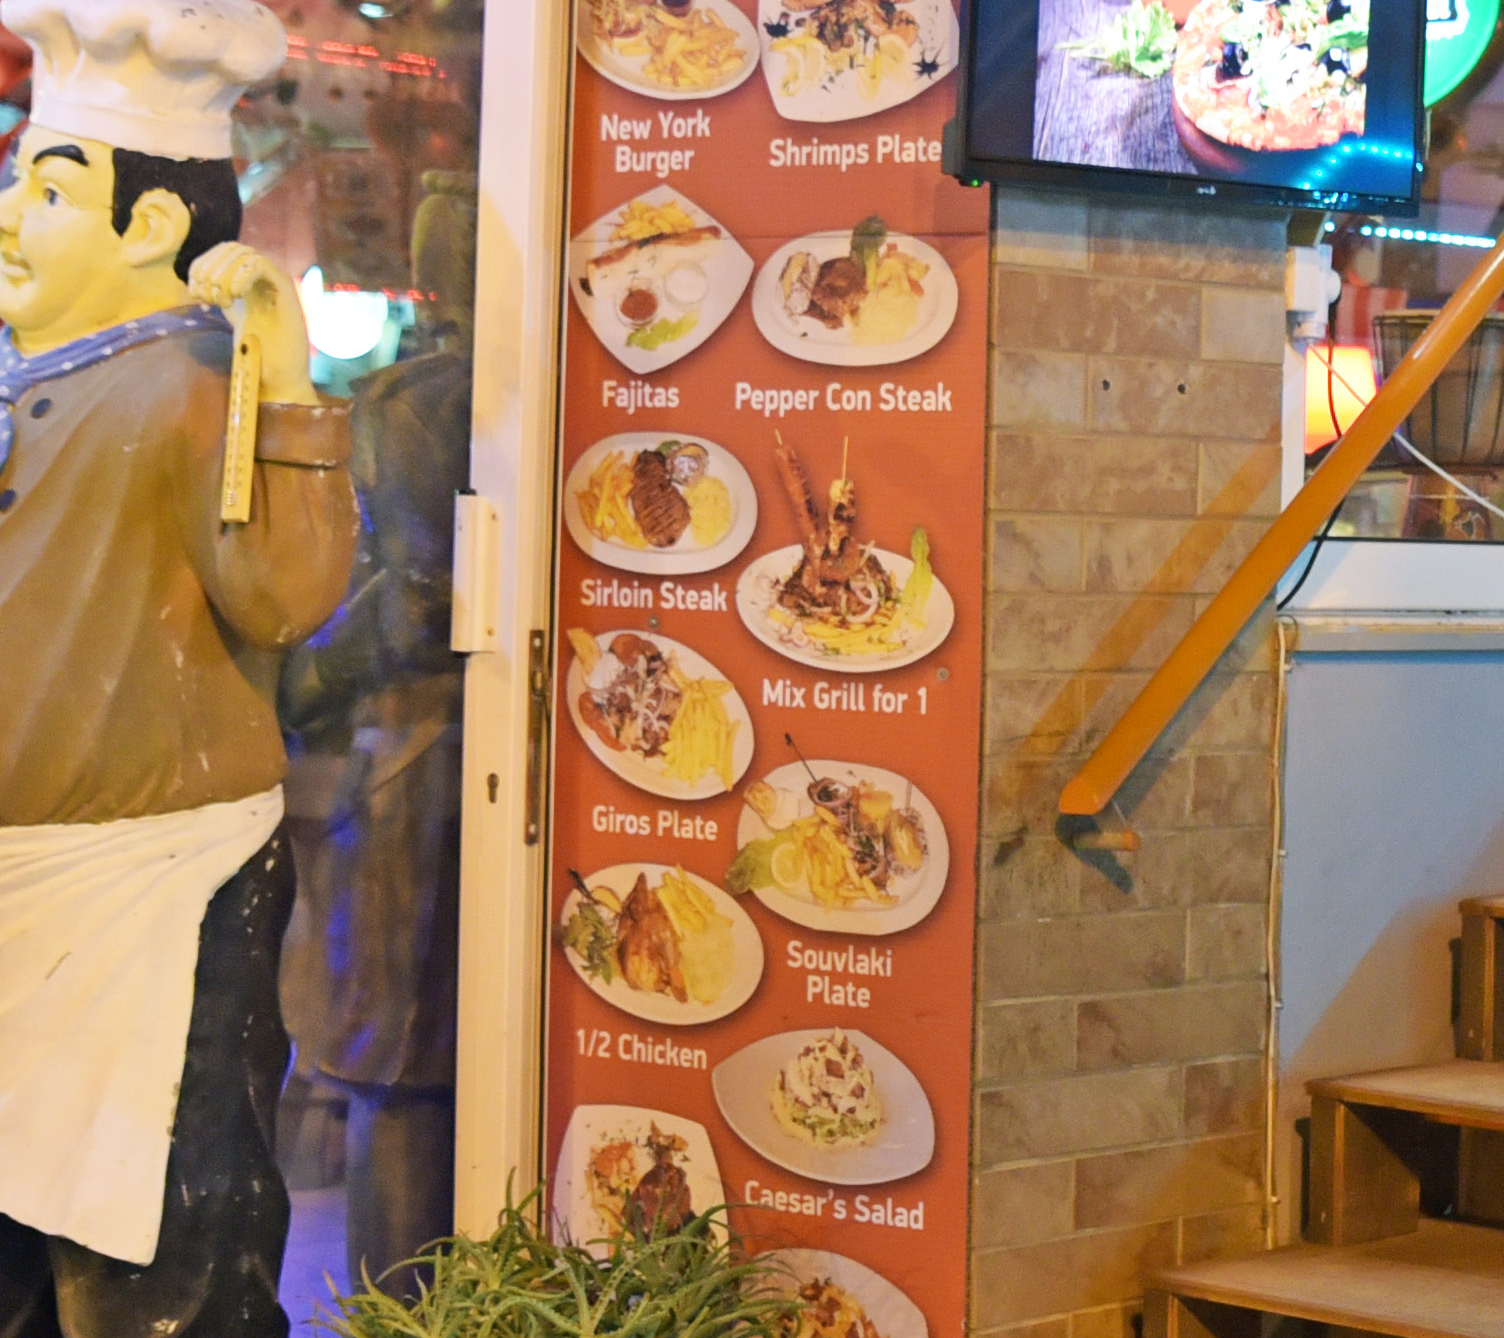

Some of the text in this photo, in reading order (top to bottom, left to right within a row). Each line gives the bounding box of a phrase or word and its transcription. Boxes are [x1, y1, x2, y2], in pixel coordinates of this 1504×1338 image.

[600, 109, 712, 144] New York
[614, 142, 696, 178] Burger
[768, 133, 943, 170] Shrimps Plate
[601, 379, 680, 412] Fajitas
[734, 381, 954, 417] Pepper Con Steak
[579, 577, 729, 613] Sirloin Steak
[761, 678, 929, 716] Mix Grill for 1
[591, 804, 719, 843] Giros Plate
[785, 939, 894, 978] Souvlaki
[804, 973, 872, 1010] Plate
[575, 1026, 709, 1073] 1/2 Chicken
[743, 1179, 927, 1233] Caesar's Salad
